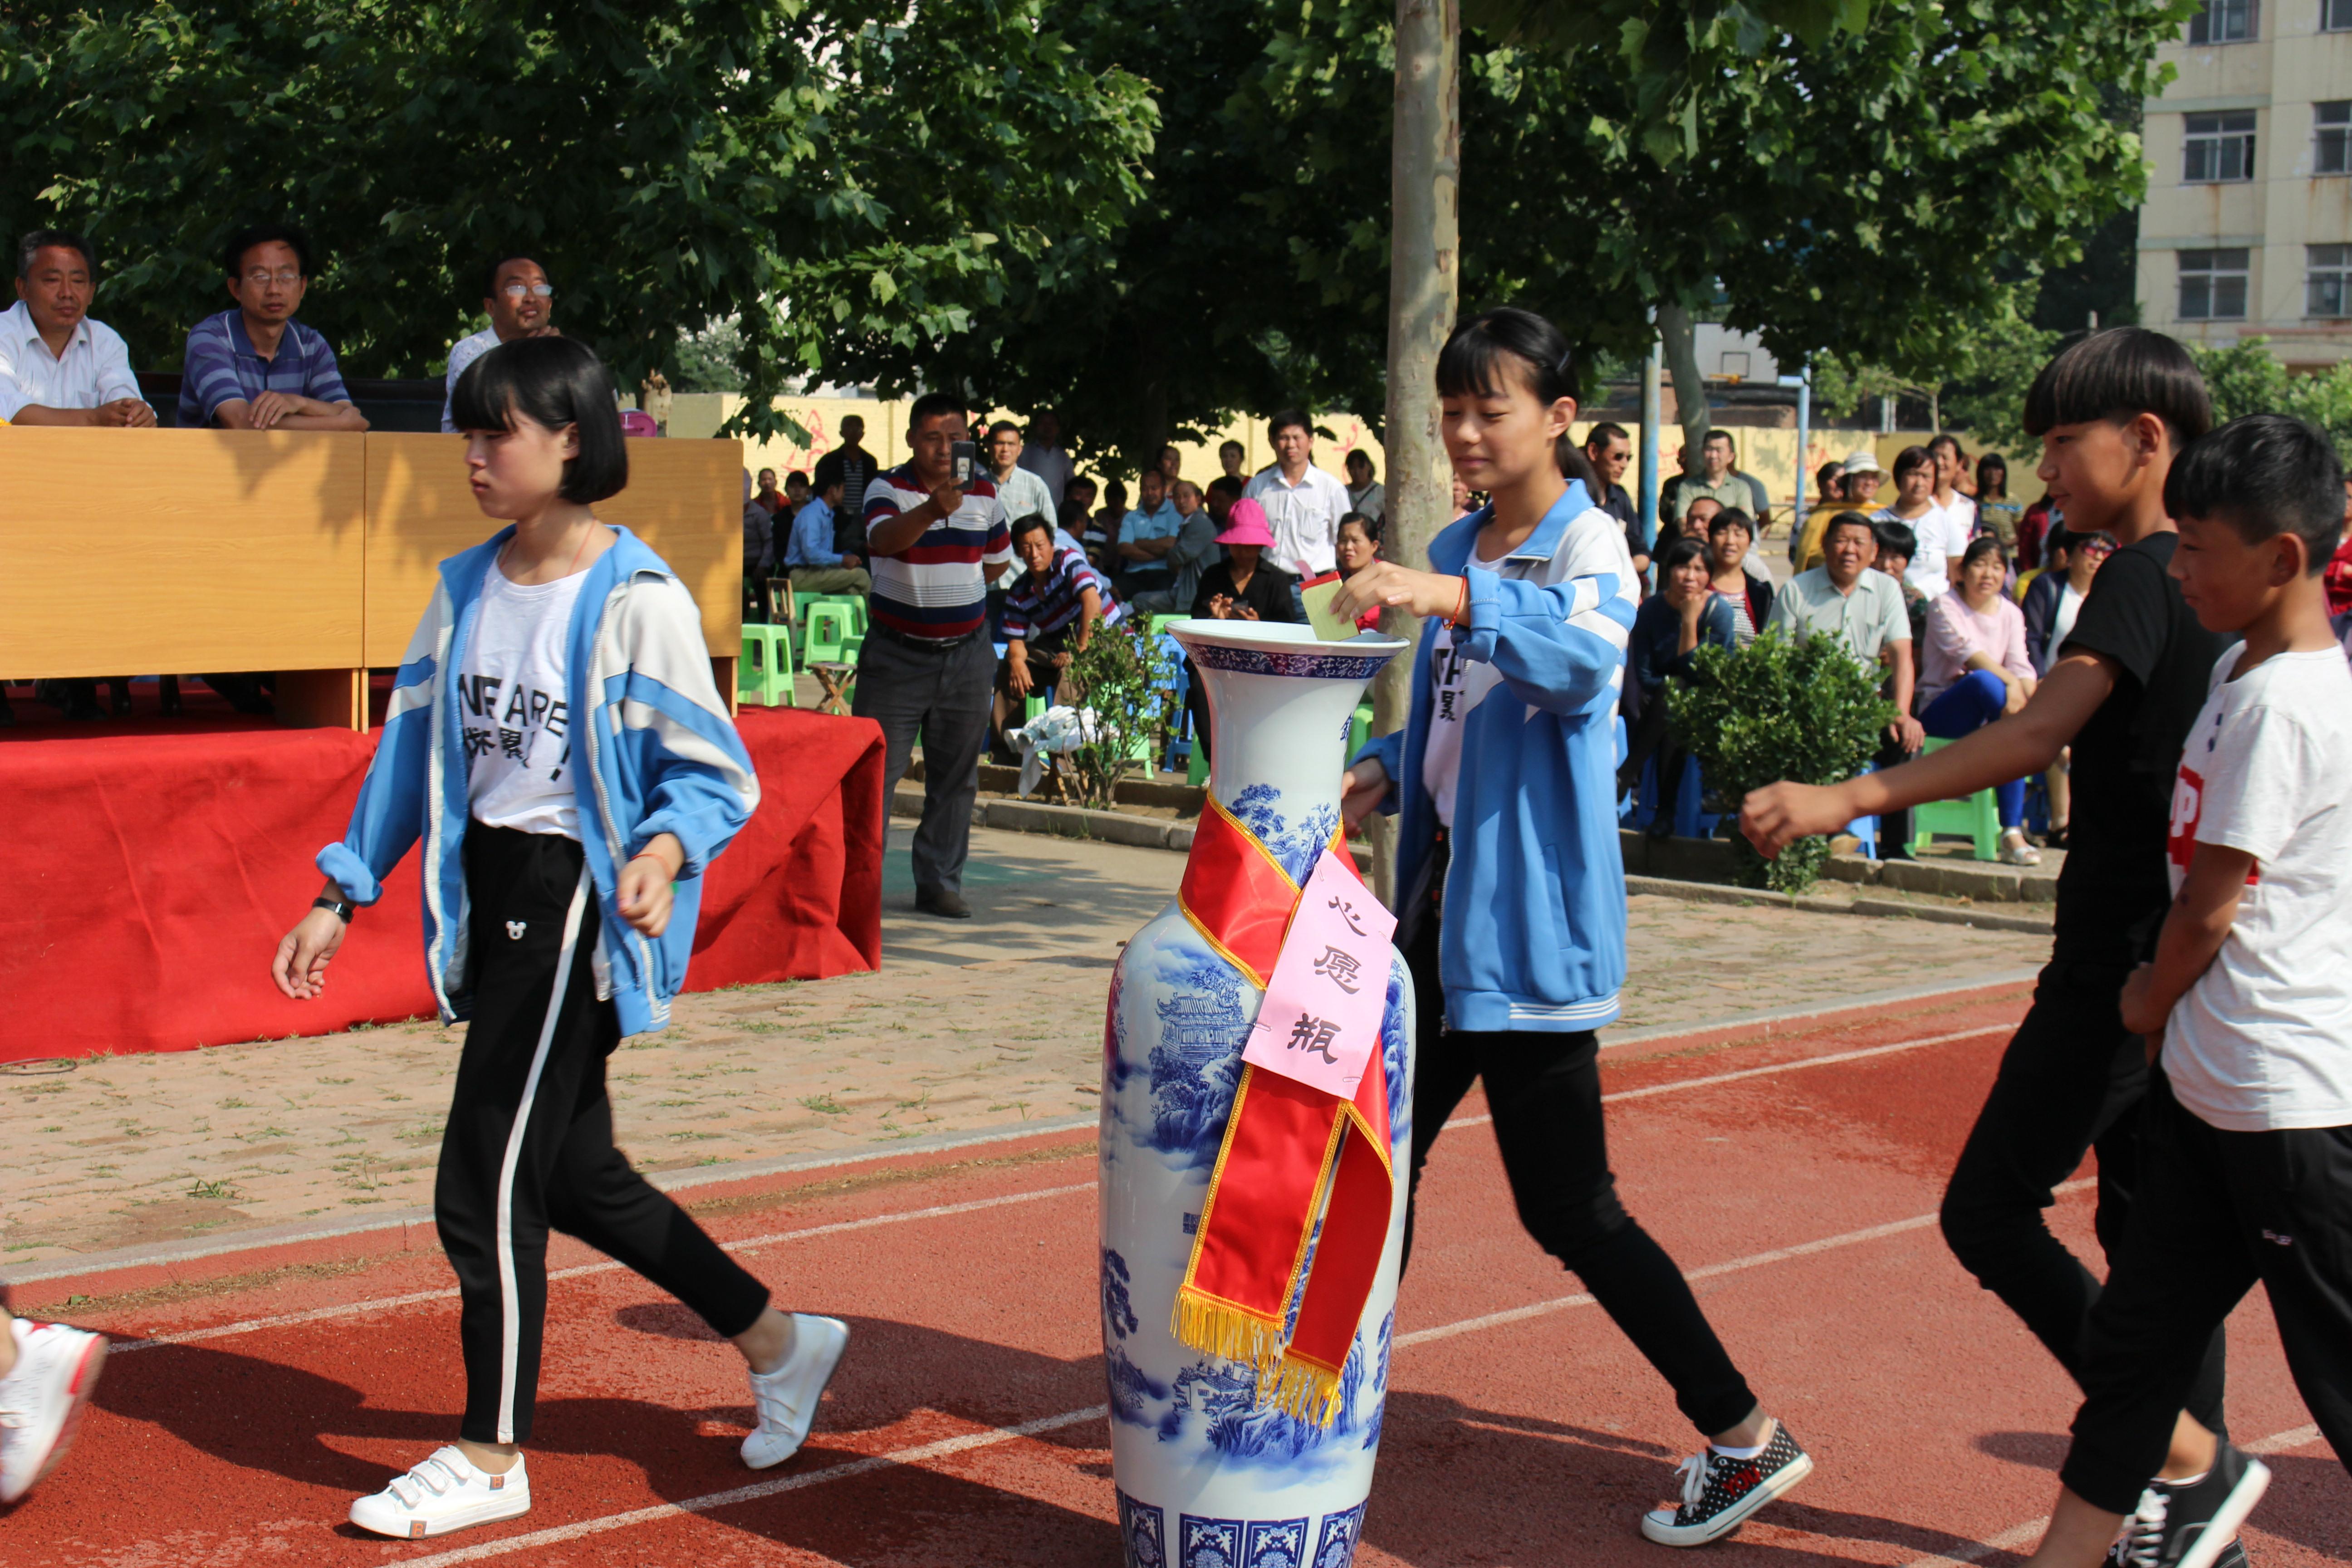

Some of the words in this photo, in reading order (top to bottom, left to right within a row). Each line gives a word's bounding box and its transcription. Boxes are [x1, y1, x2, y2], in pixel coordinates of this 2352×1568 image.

[505, 684, 569, 738] ARE
[1287, 895, 1367, 1065] 心愿瓶
[493, 1475, 502, 1488] B
[1722, 1464, 1761, 1496] YOU
[412, 1523, 423, 1537] B
